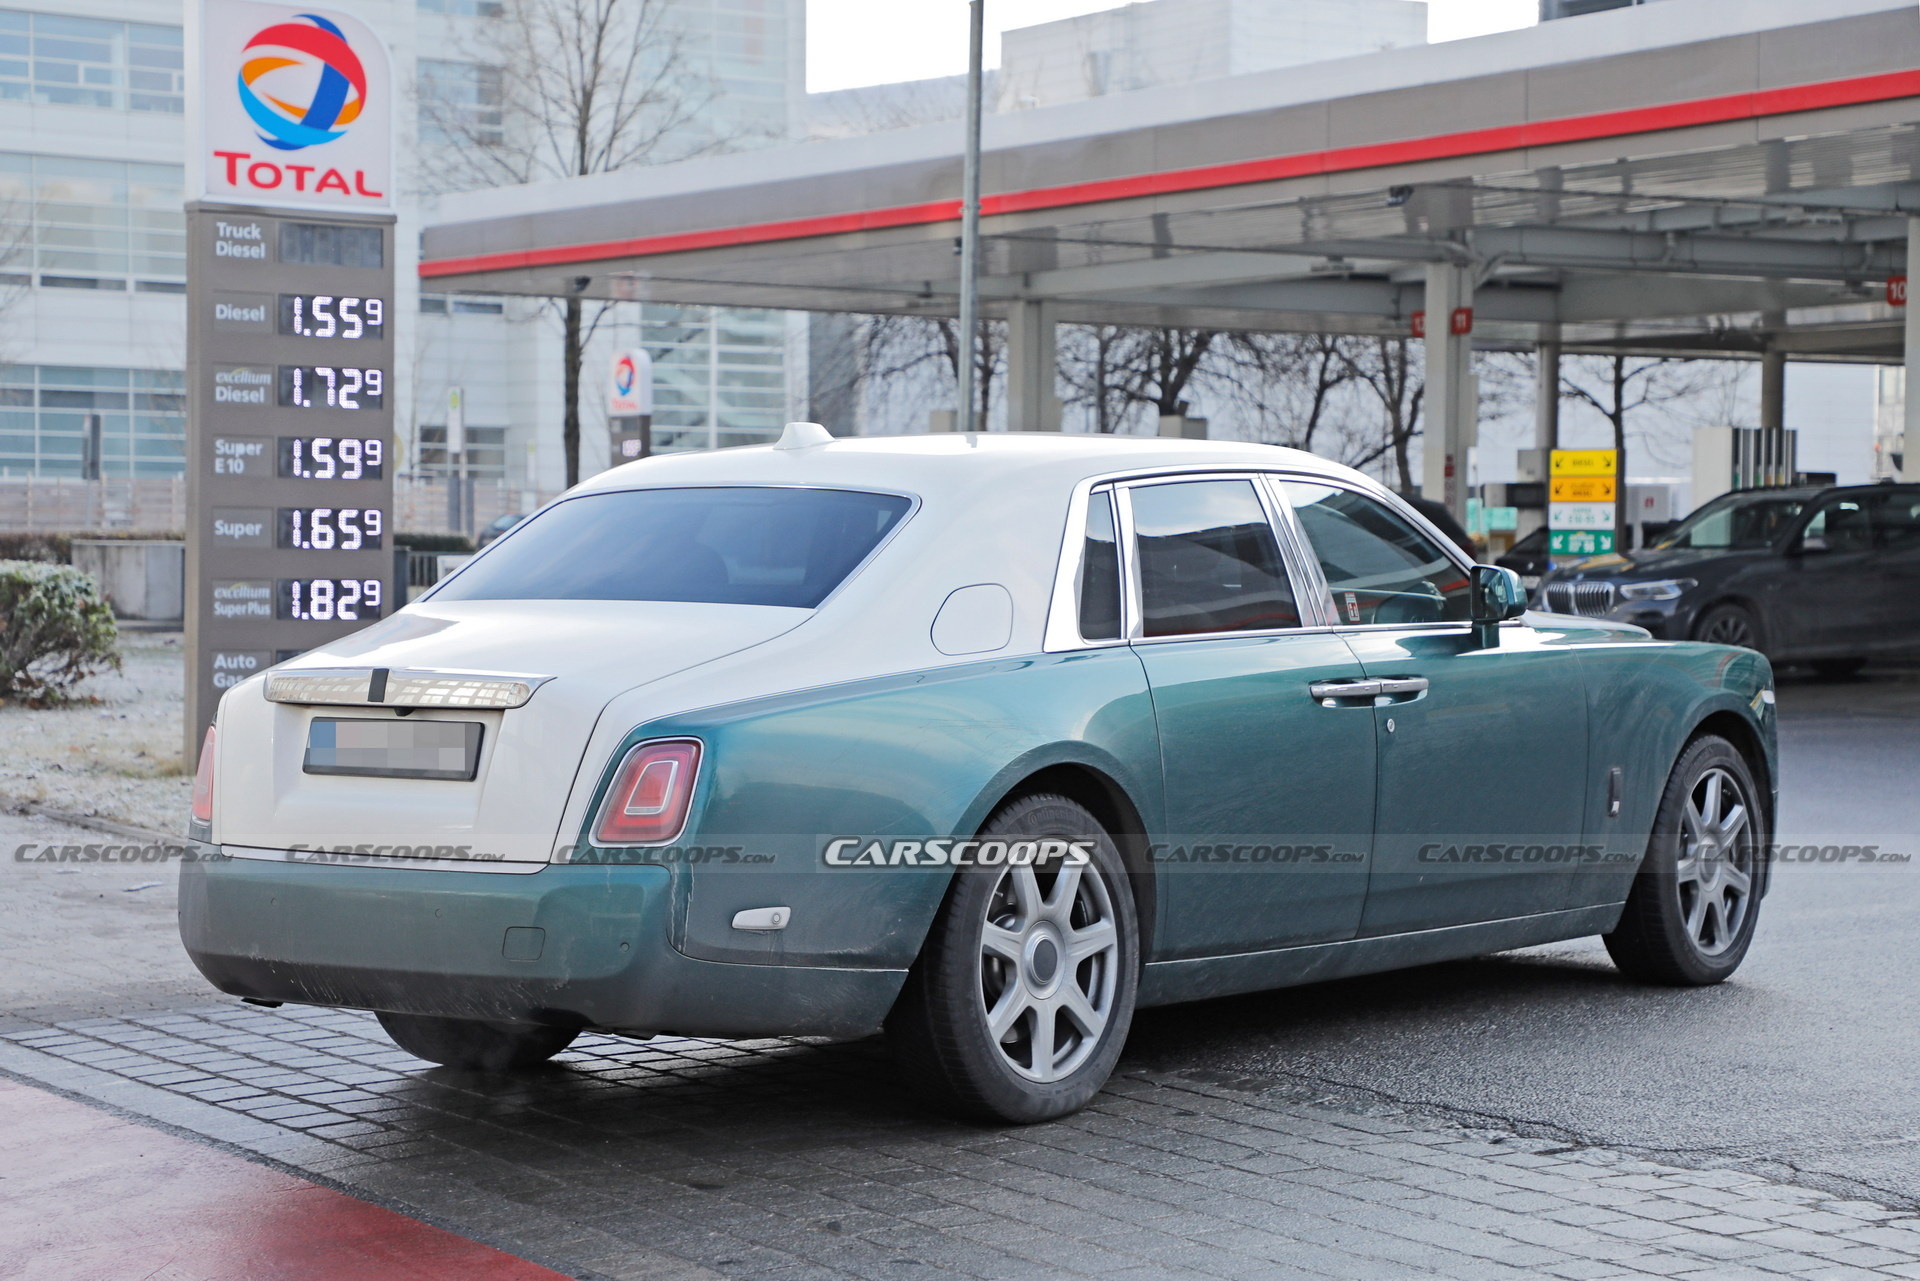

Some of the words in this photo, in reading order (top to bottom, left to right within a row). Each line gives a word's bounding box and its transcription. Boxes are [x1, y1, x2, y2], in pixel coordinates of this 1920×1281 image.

[213, 150, 383, 198] TOTAL
[215, 241, 265, 259] Diesel
[216, 221, 262, 240] Truck
[1890, 281, 1906, 301] 10
[215, 303, 265, 321] Diesel
[293, 295, 383, 339] 1.559
[215, 370, 272, 385] excellium
[293, 366, 383, 410] 1.729
[215, 386, 265, 403] Diesel
[215, 438, 263, 458] Super
[293, 437, 383, 480] 1.599
[214, 519, 263, 539] Super
[292, 508, 382, 551] 1.659
[292, 579, 382, 621] 1.829
[213, 653, 257, 670] Auto
